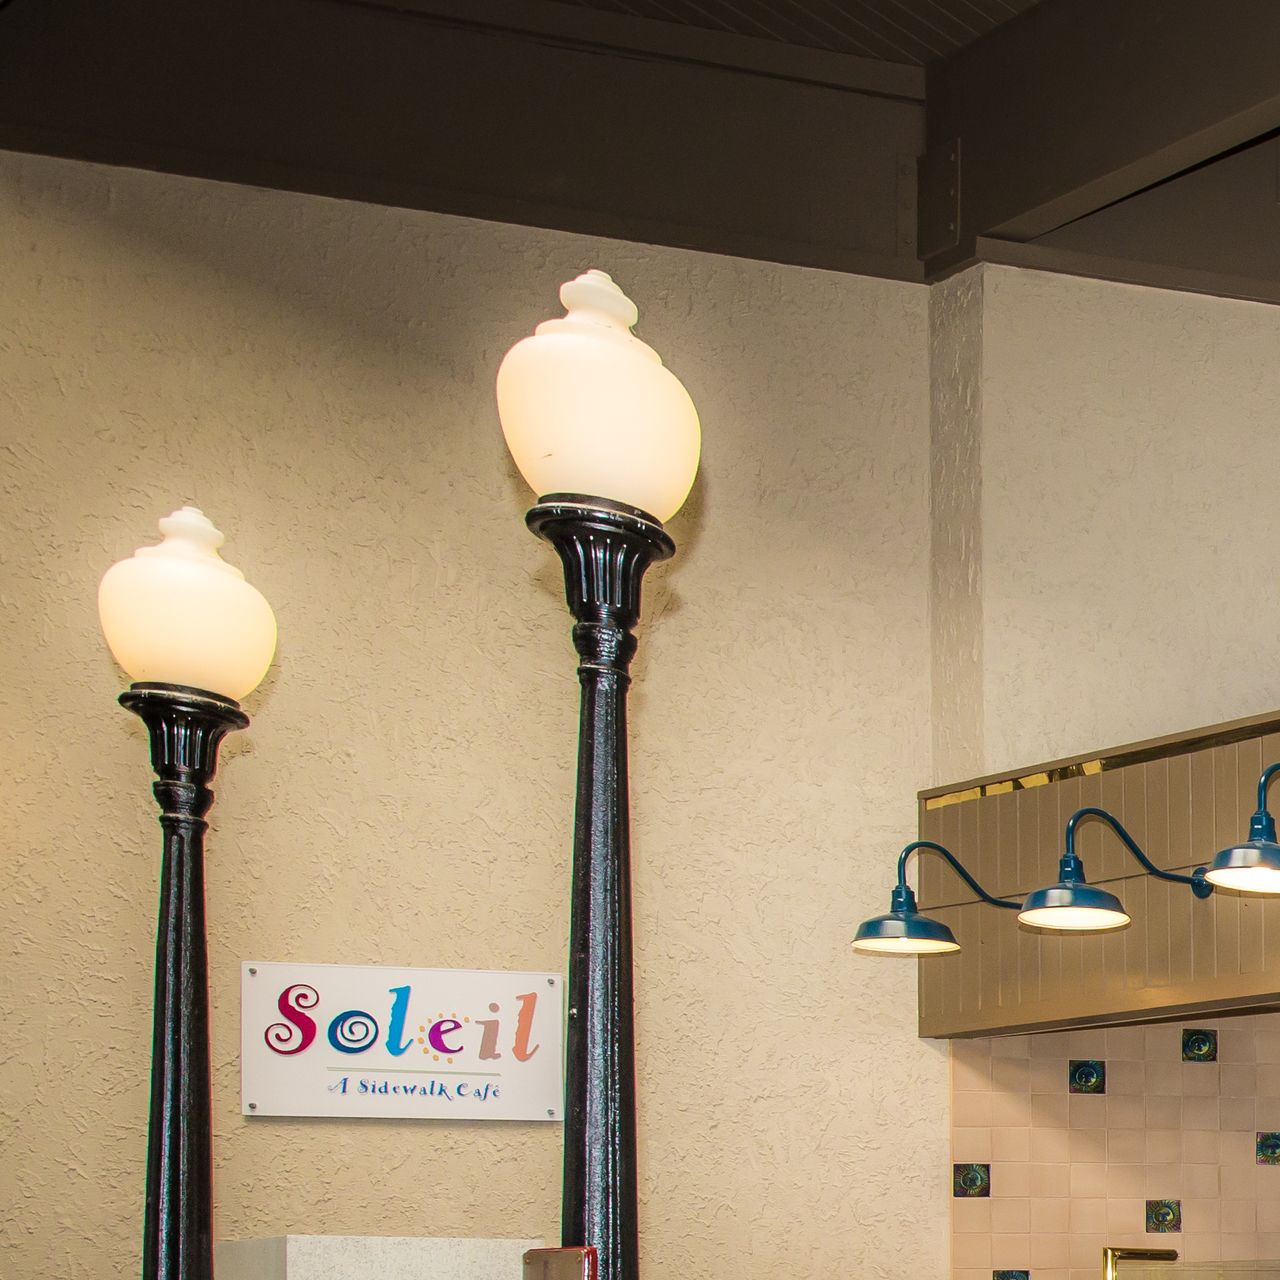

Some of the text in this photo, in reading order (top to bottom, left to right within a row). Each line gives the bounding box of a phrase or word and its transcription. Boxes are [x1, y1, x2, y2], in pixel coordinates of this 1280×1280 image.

[264, 983, 540, 1062] Soleil
[327, 1077, 349, 1095] A
[357, 1078, 453, 1101] Sidewalk
